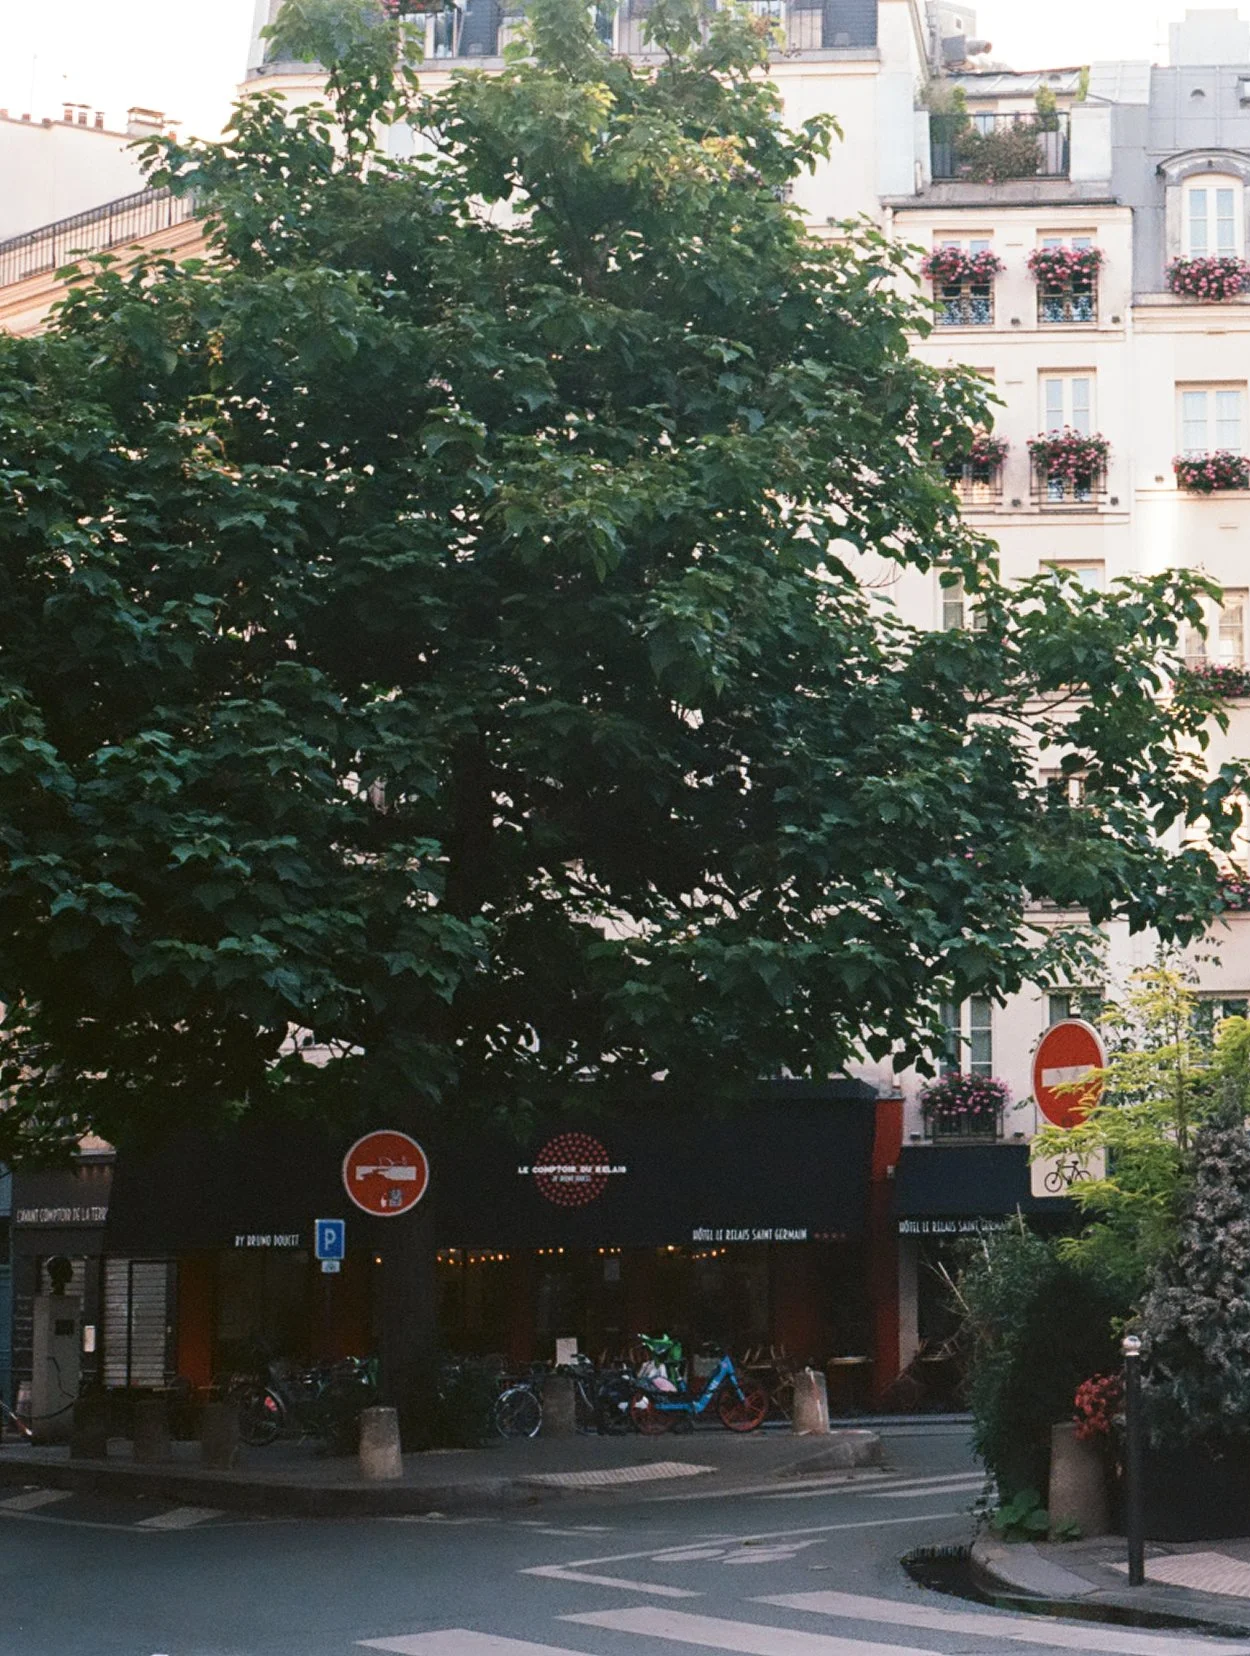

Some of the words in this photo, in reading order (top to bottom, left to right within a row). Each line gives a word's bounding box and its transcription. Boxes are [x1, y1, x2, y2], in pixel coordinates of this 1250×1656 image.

[518, 1166, 529, 1174] LE
[532, 1165, 576, 1173] COMPTOIR
[580, 1165, 592, 1173] DU
[595, 1165, 626, 1173] RELAIS
[324, 1228, 336, 1252] P
[715, 1228, 723, 1240] LE
[725, 1228, 750, 1240] RELAIS
[751, 1228, 773, 1240] SAINT
[774, 1228, 807, 1241] GERMAIN
